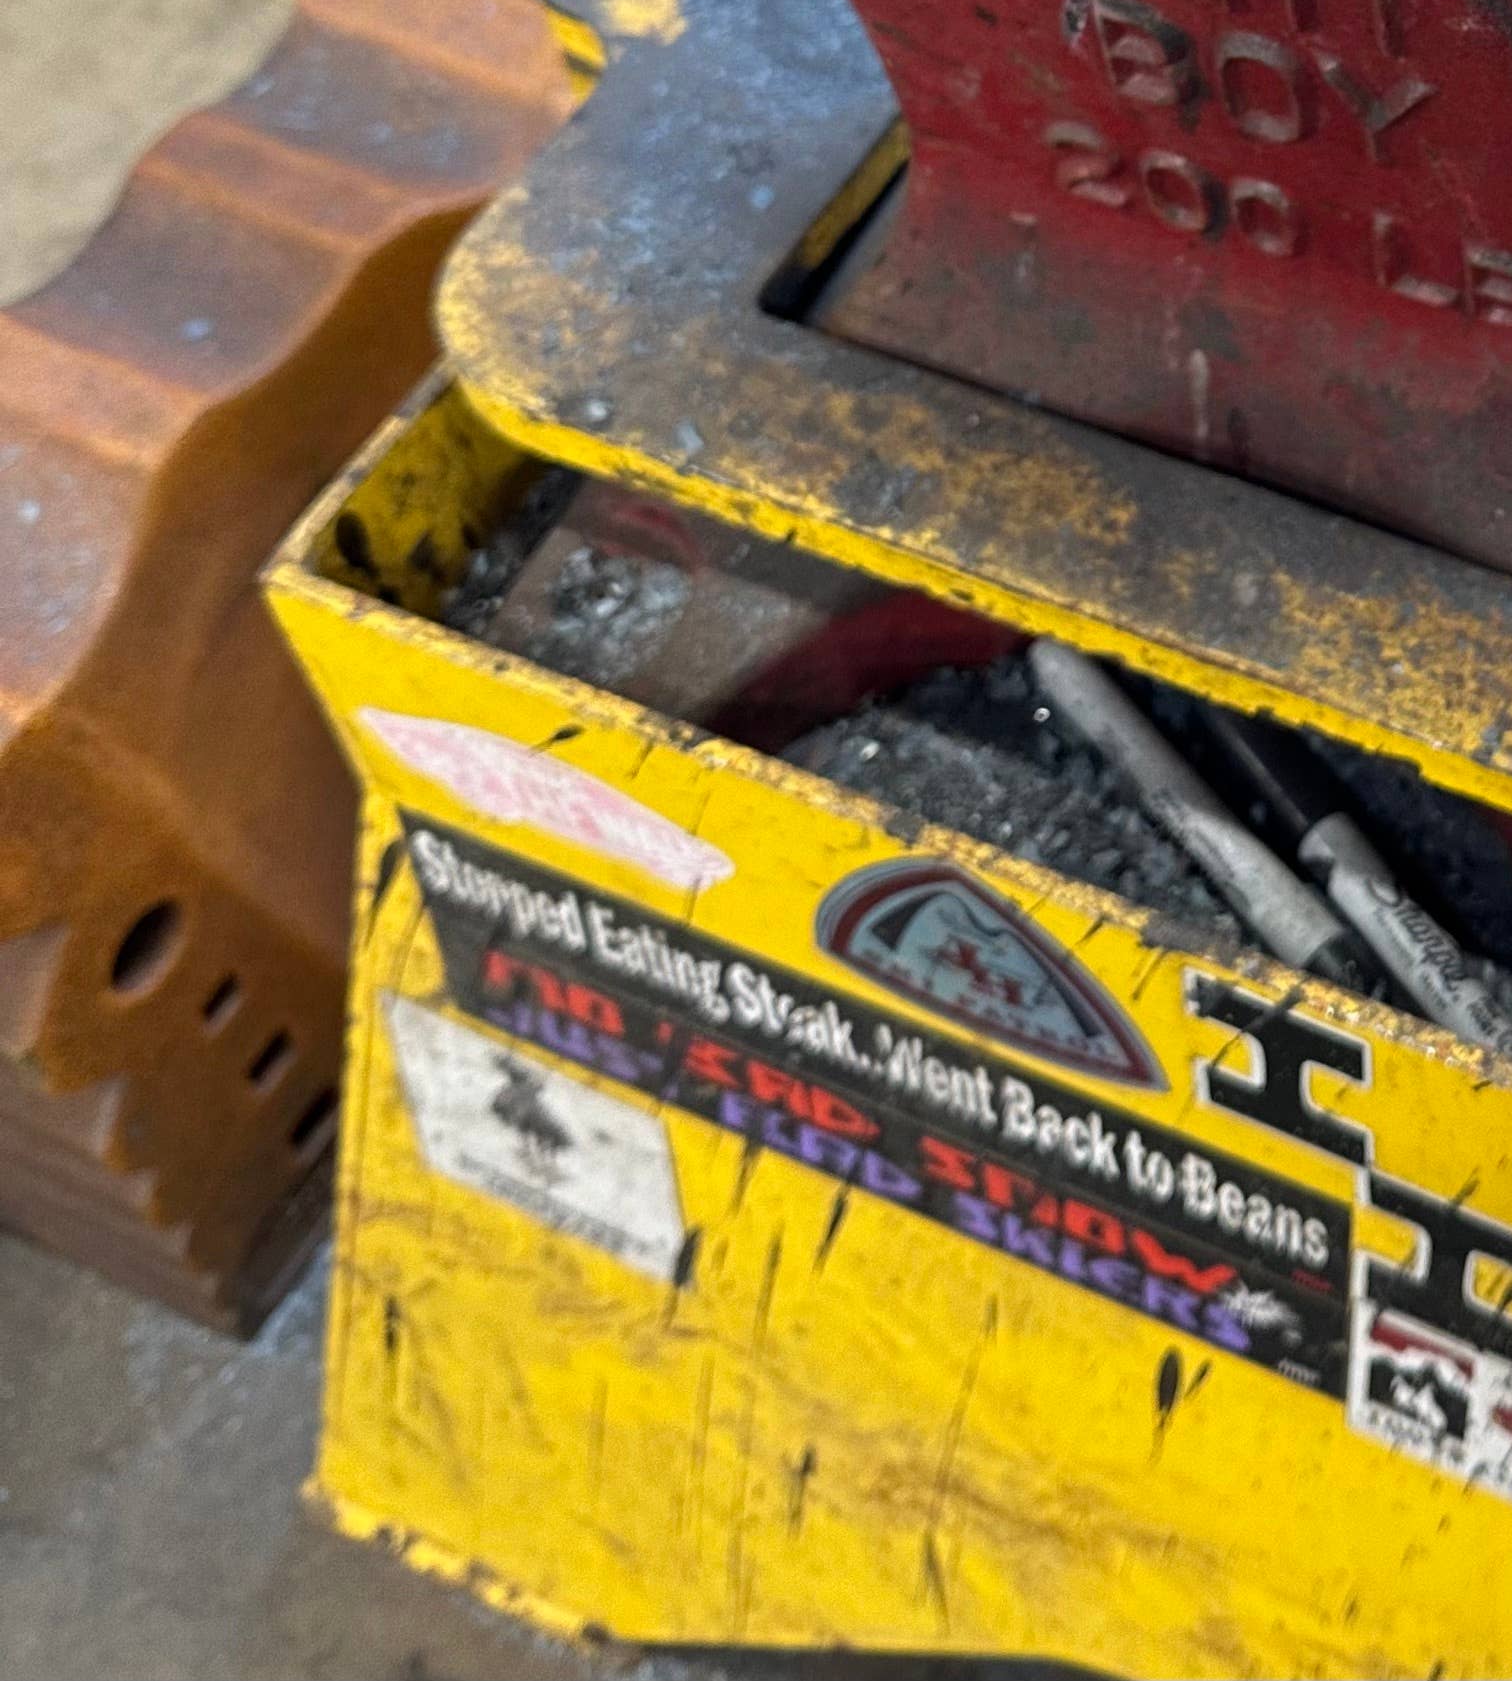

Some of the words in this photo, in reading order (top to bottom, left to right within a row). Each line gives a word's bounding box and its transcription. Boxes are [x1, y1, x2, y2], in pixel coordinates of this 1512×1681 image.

[1042, 121, 1302, 260] 200
[585, 899, 731, 1023] Eating
[1001, 1074, 1121, 1181] Back
[1123, 1129, 1176, 1204] to
[1178, 1151, 1330, 1269] Beans
